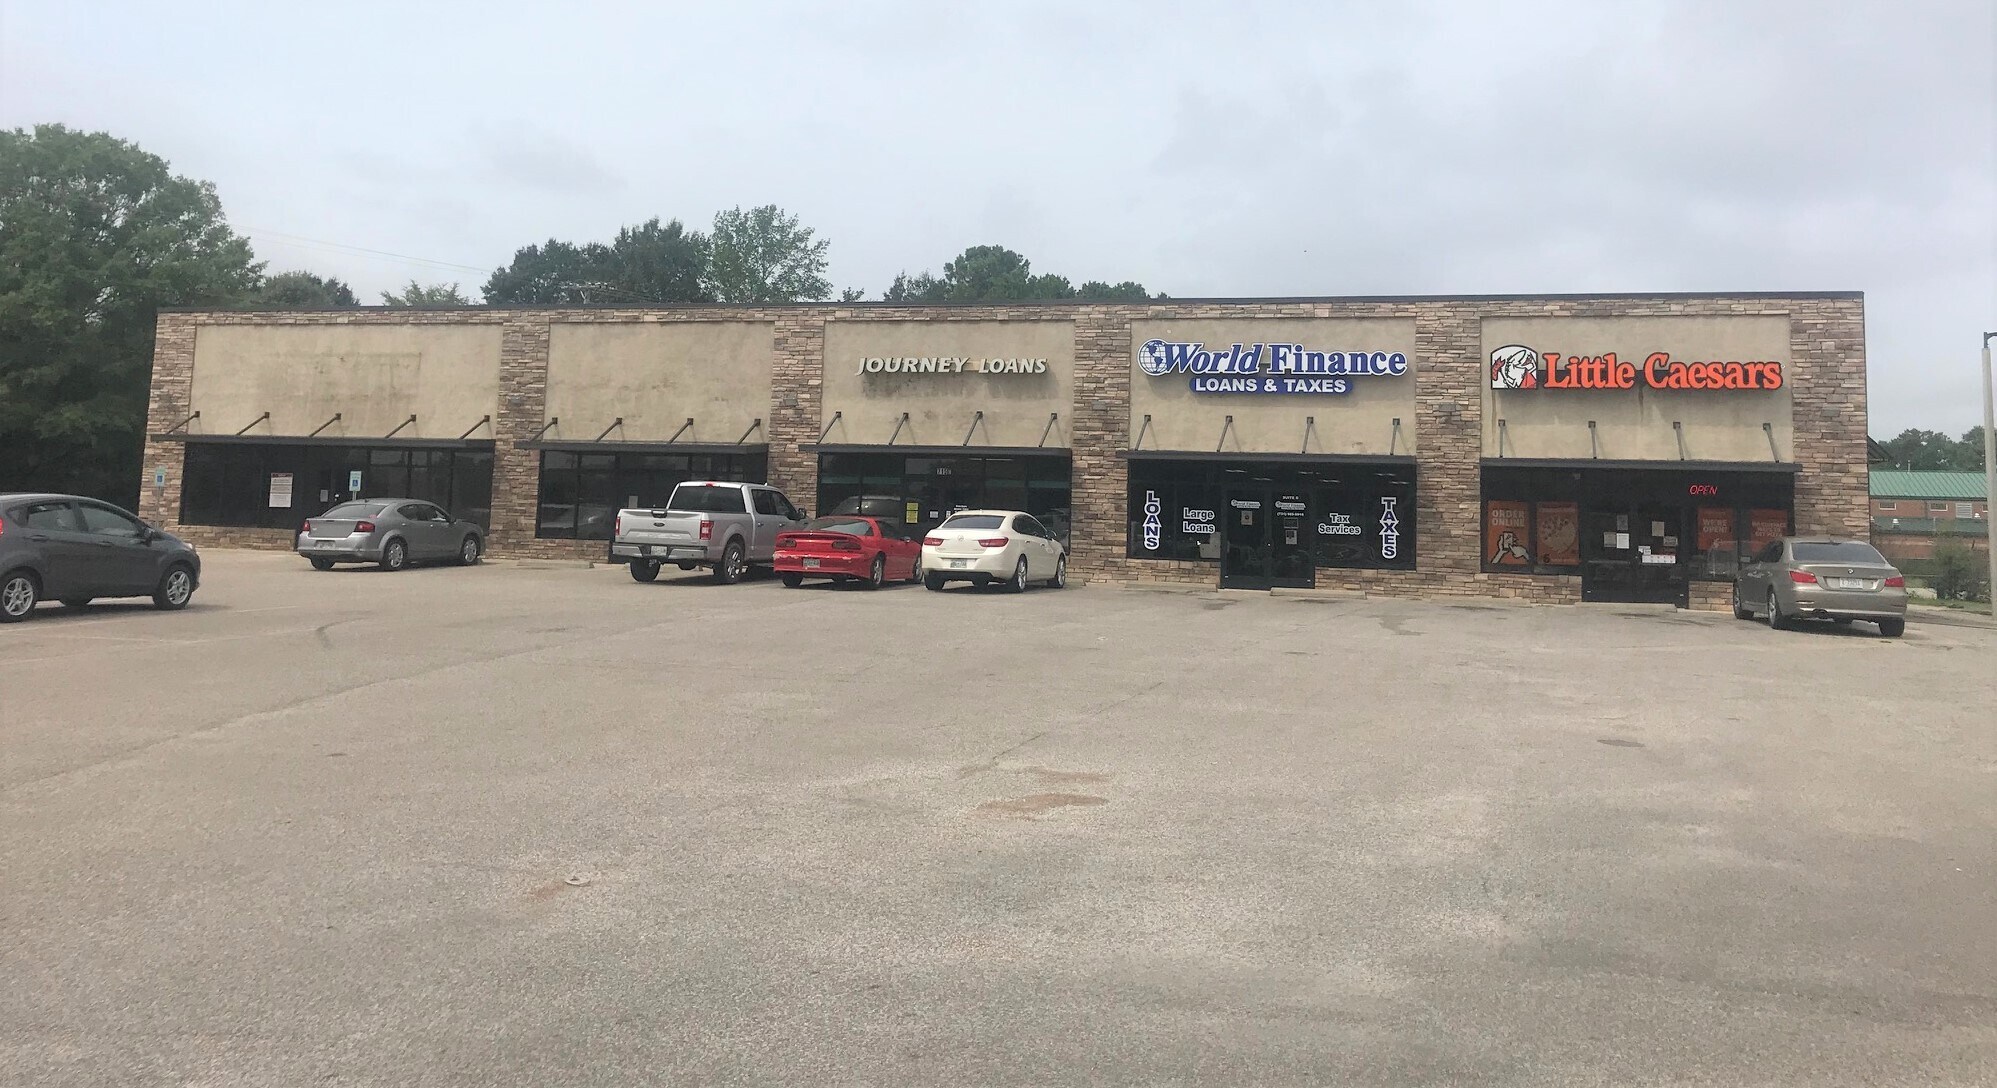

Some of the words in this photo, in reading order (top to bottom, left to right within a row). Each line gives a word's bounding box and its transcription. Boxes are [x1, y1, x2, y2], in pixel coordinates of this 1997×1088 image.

[1164, 343, 1262, 373] World
[1267, 342, 1408, 374] Finance
[855, 357, 970, 376] JOURNEY
[978, 358, 1047, 374] LOANS
[1542, 352, 1635, 389] Little
[1643, 352, 1783, 389] Caesars
[1195, 378, 1258, 393] LOANS
[1263, 378, 1277, 393] &
[1284, 378, 1346, 393] TAXES
[1689, 485, 1718, 495] OPEN
[1143, 490, 1162, 550] LOANS
[1183, 507, 1215, 522] Large
[1329, 513, 1350, 524] Tax
[1491, 509, 1525, 518] ORDER
[1182, 521, 1215, 534] Loans
[1318, 523, 1361, 535] Services
[1379, 496, 1400, 559] TAXES
[1491, 518, 1525, 528] ONLINE
